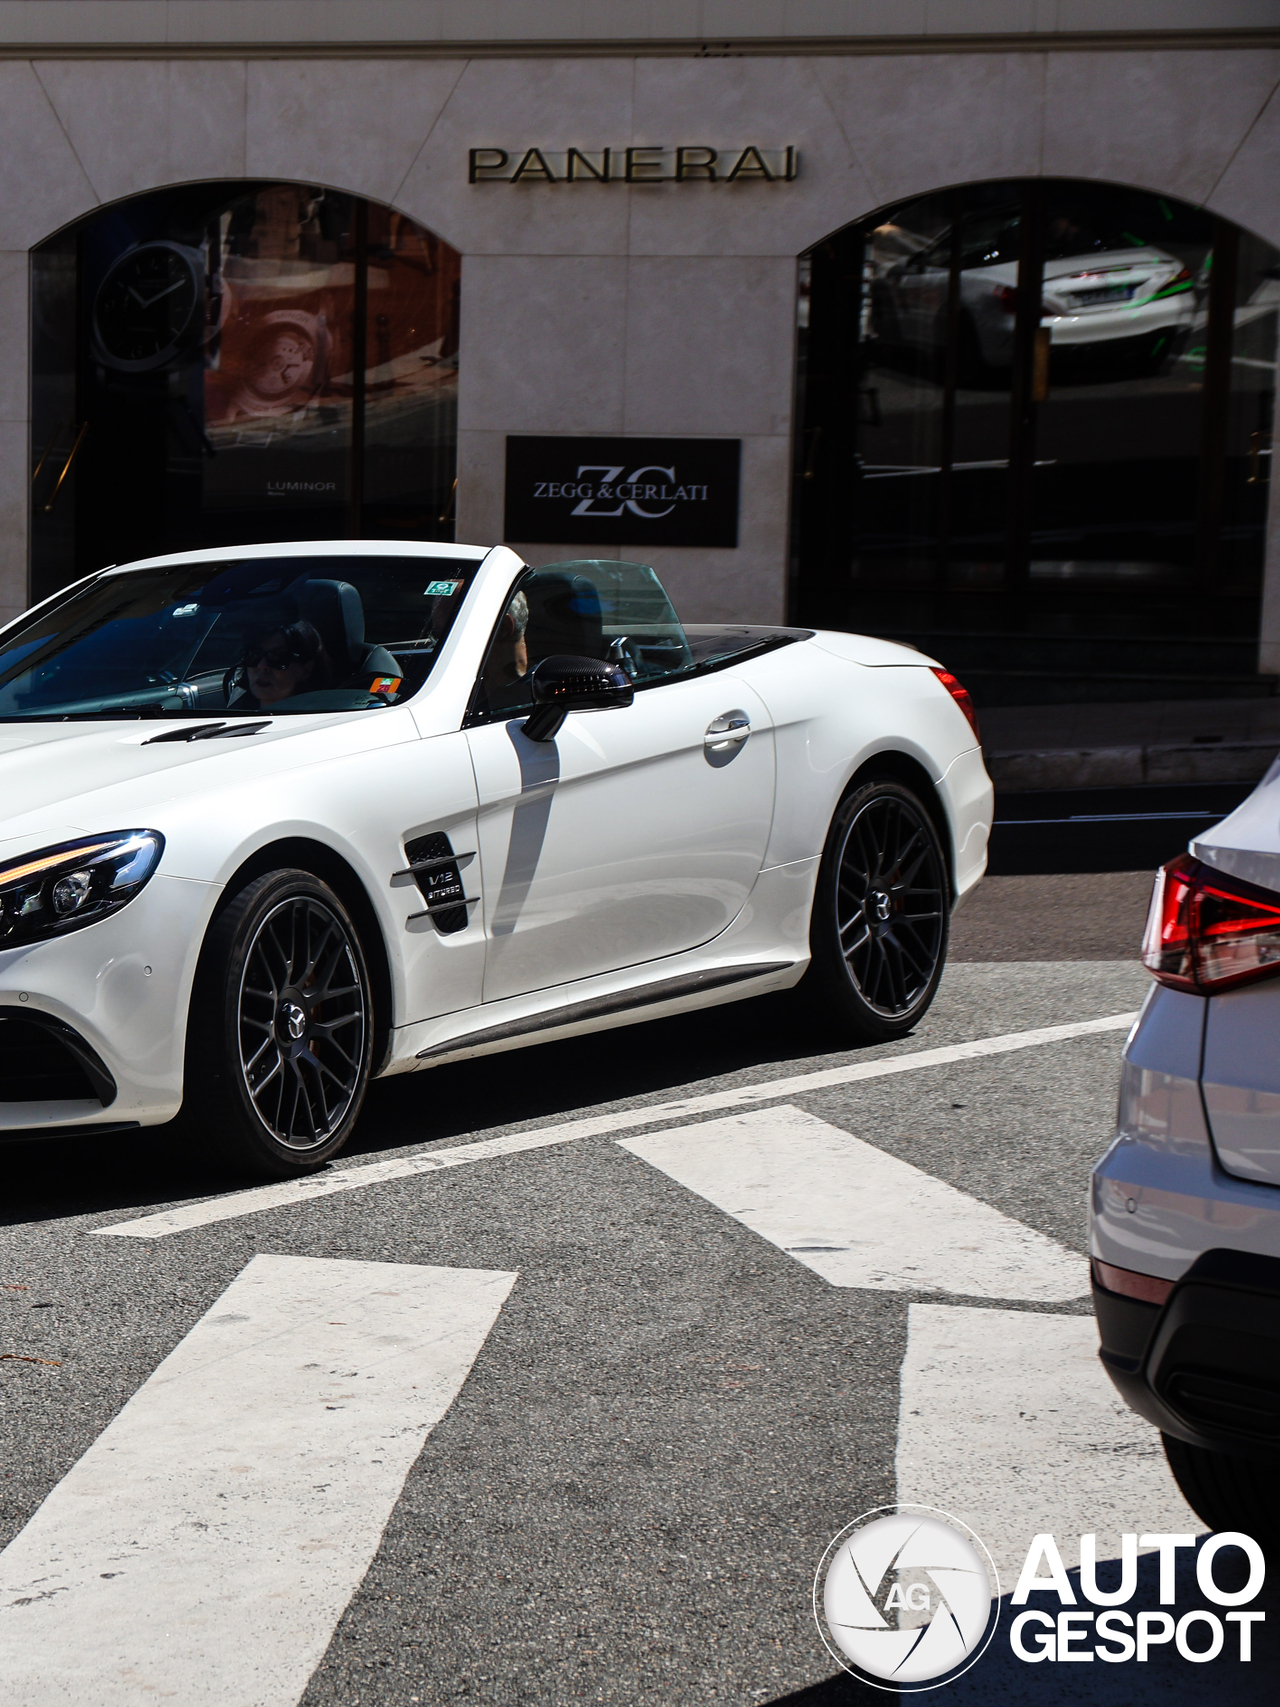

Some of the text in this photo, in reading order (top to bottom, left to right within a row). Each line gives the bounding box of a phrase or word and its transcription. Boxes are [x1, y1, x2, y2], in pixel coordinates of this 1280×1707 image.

[468, 145, 797, 184] PANERAI
[267, 481, 336, 491] LUMINOR
[533, 482, 593, 498] ZEGG
[615, 484, 709, 500] CERLATI
[429, 872, 453, 885] V12
